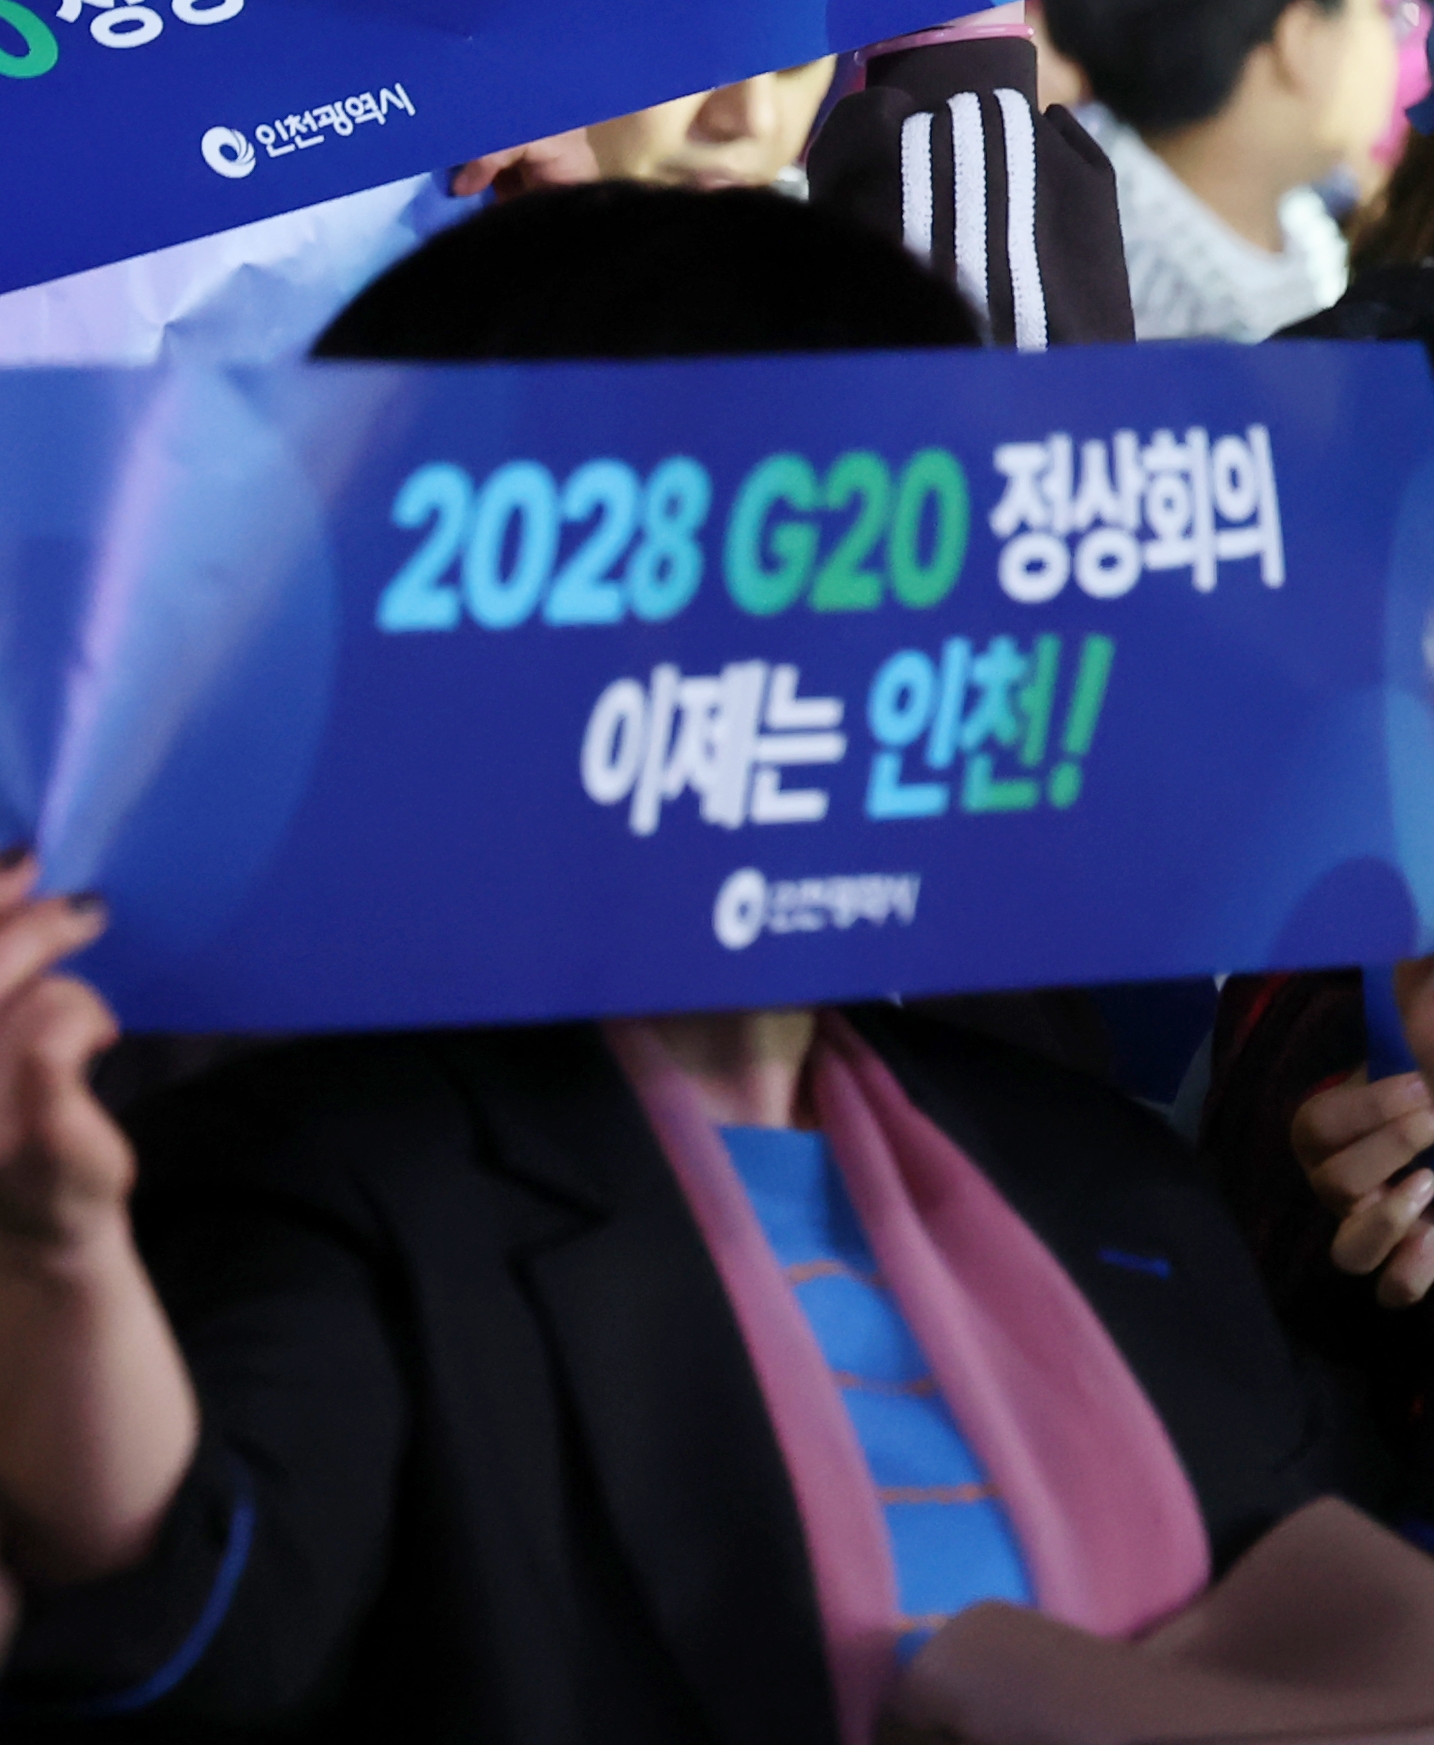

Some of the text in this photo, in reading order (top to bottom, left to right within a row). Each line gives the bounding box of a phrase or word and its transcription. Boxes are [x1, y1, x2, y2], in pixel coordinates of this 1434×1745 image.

[254, 82, 415, 161] 인천광역시
[378, 424, 1286, 632] 2028 G20 정상회의
[580, 636, 1115, 836] 이제는 인천!
